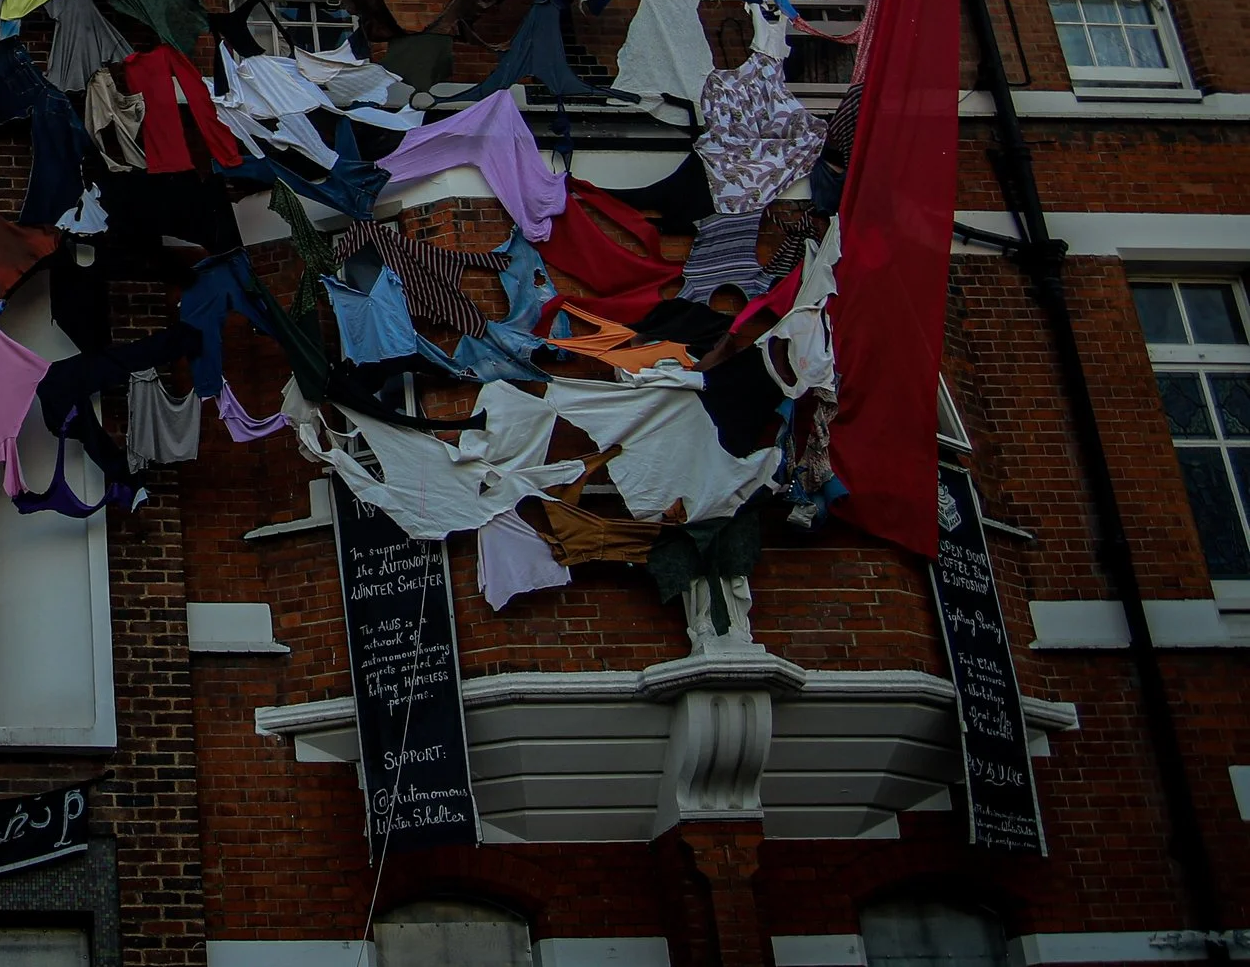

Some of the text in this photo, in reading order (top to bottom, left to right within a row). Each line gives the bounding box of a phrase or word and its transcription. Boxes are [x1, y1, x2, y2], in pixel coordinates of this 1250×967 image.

[369, 537, 410, 561] support
[966, 548, 988, 568] DOOR
[356, 564, 374, 578] the
[938, 553, 970, 576] COFFEE
[351, 573, 444, 600] WINTER SHELTER
[359, 624, 373, 636] The
[378, 618, 401, 632] AWS
[405, 620, 413, 628] is
[361, 643, 450, 668] autonomous housing
[365, 664, 396, 685] projects
[435, 654, 447, 666] at
[369, 683, 398, 699] helping
[413, 805, 467, 828] Shelter
